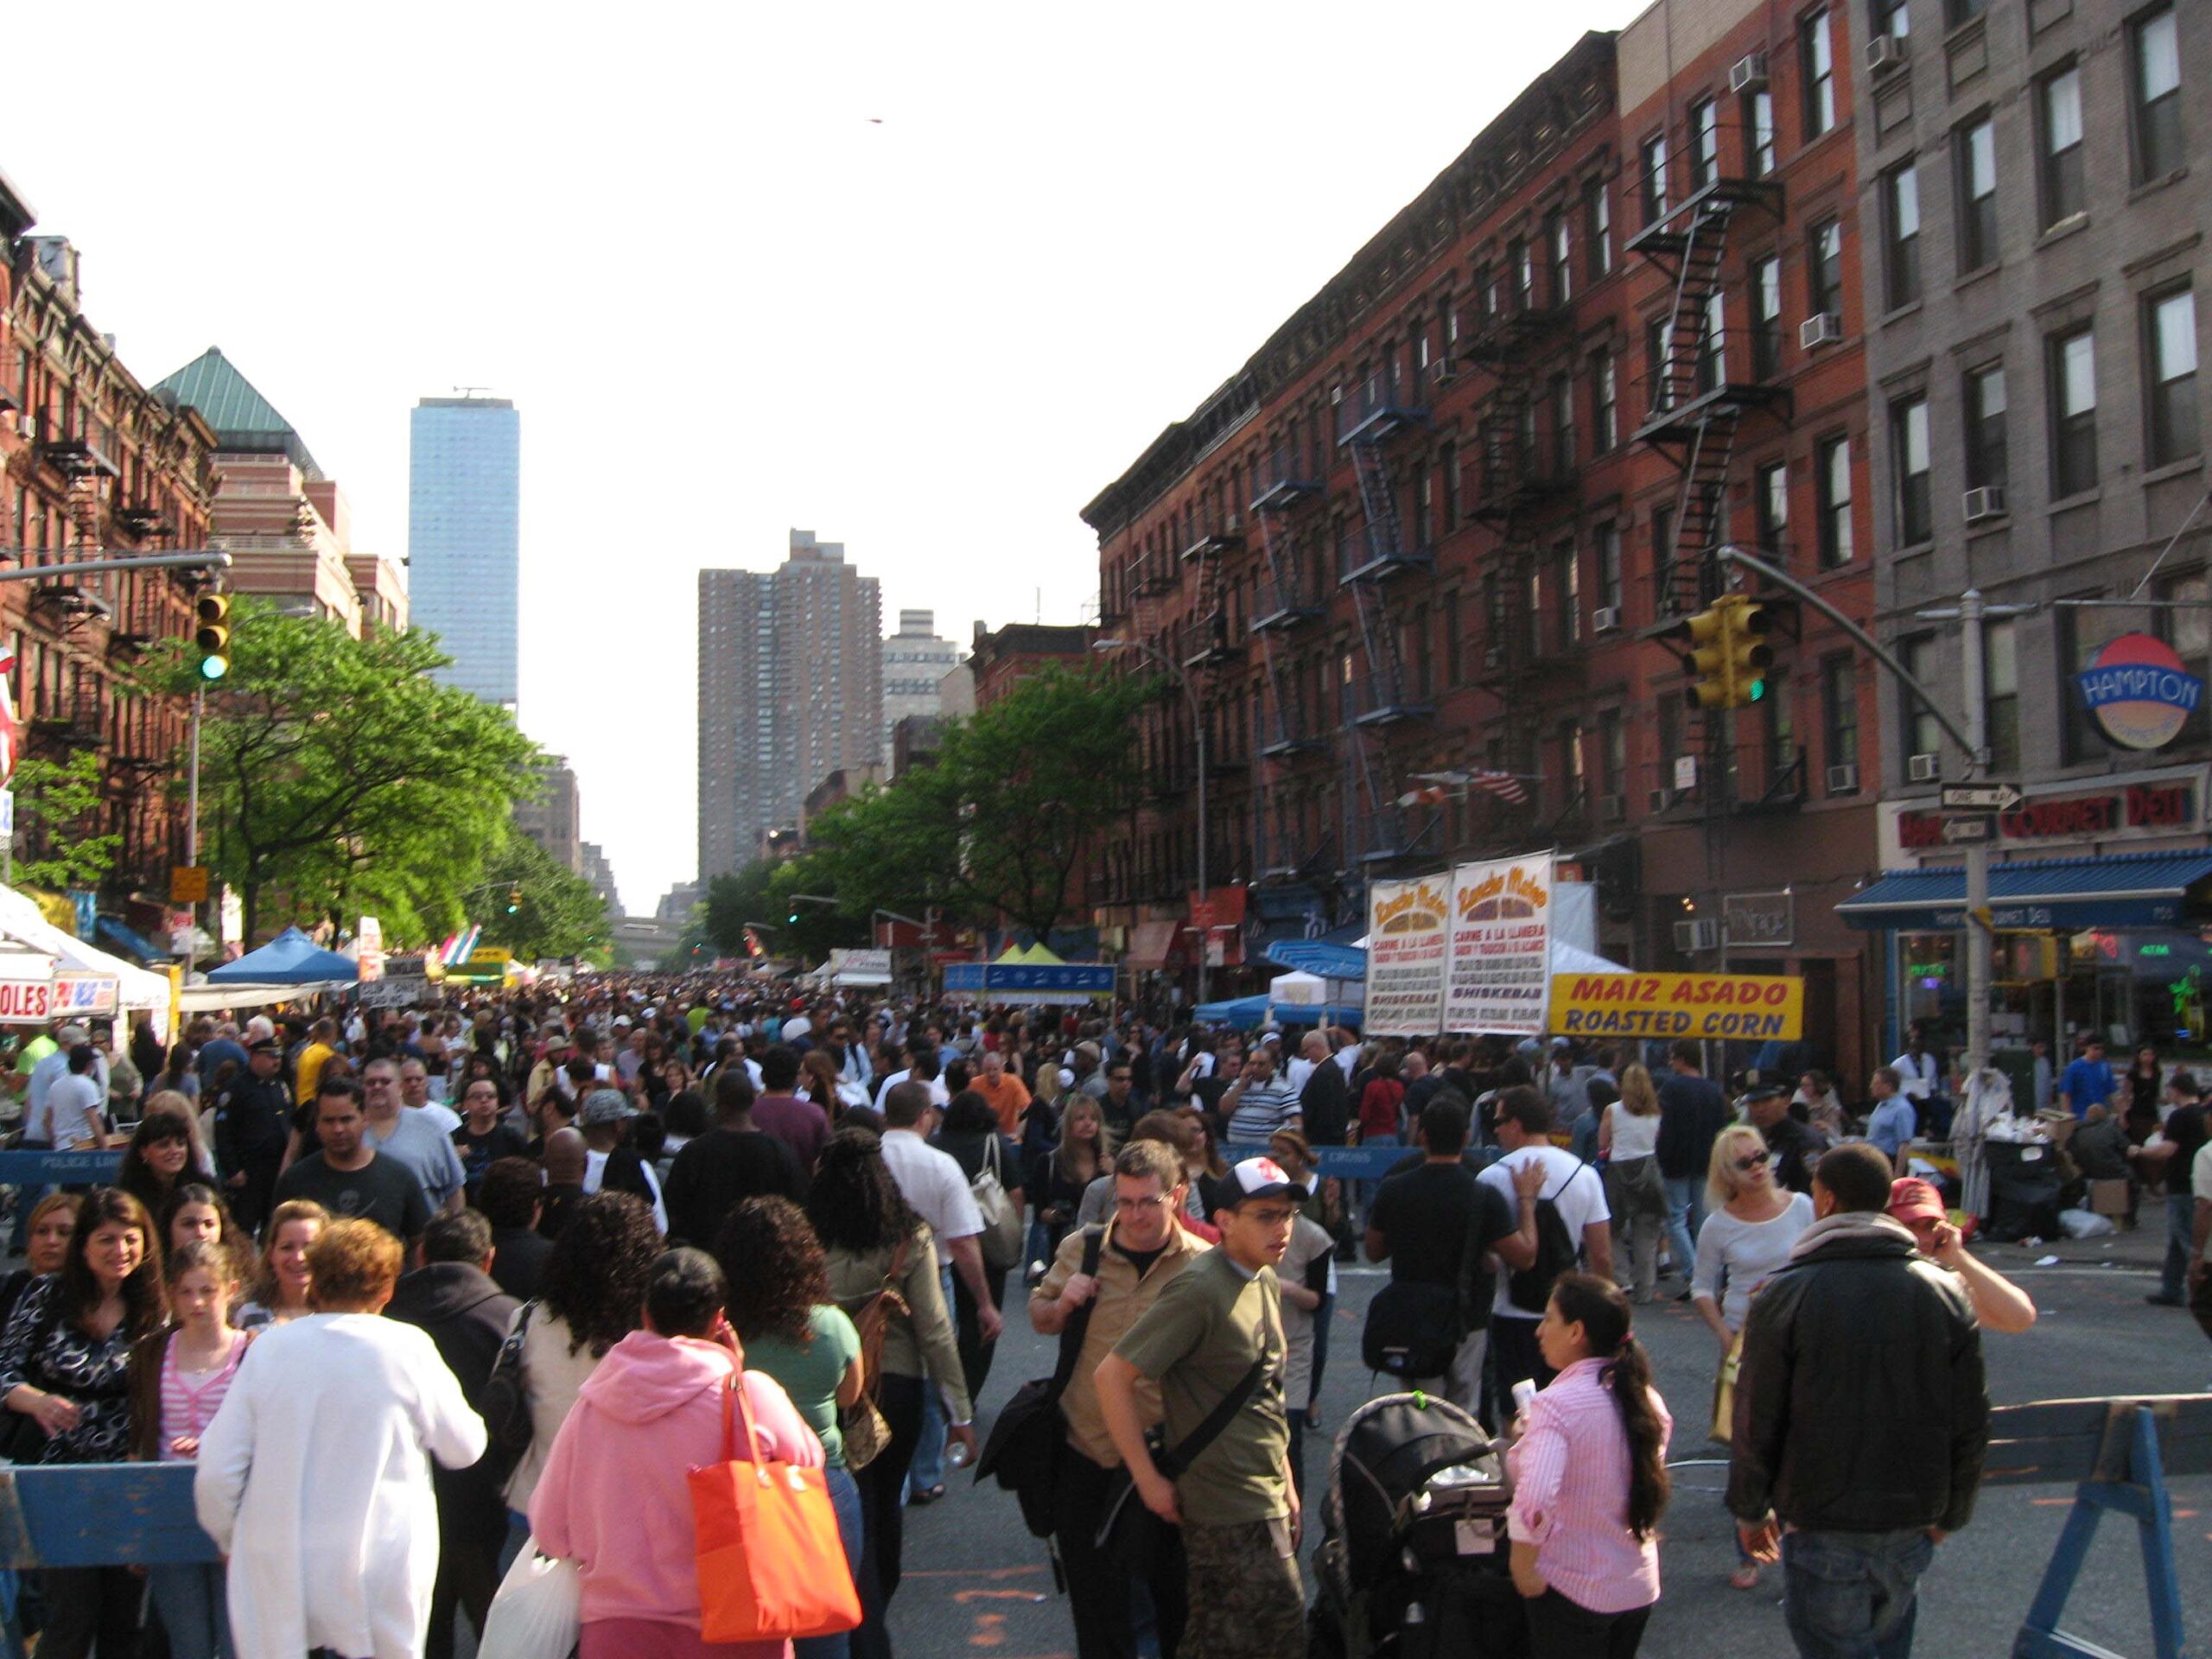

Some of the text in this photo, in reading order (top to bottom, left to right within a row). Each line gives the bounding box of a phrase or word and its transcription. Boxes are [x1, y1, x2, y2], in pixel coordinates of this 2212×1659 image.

[2082, 668, 2201, 708] HAMPTON
[1569, 977, 1662, 1002] MAIZ
[1669, 978, 1789, 1006] ASADO
[1564, 1008, 1692, 1033] ROASTED
[1702, 1010, 1786, 1036] CORN
[41, 1155, 92, 1169] POLICE
